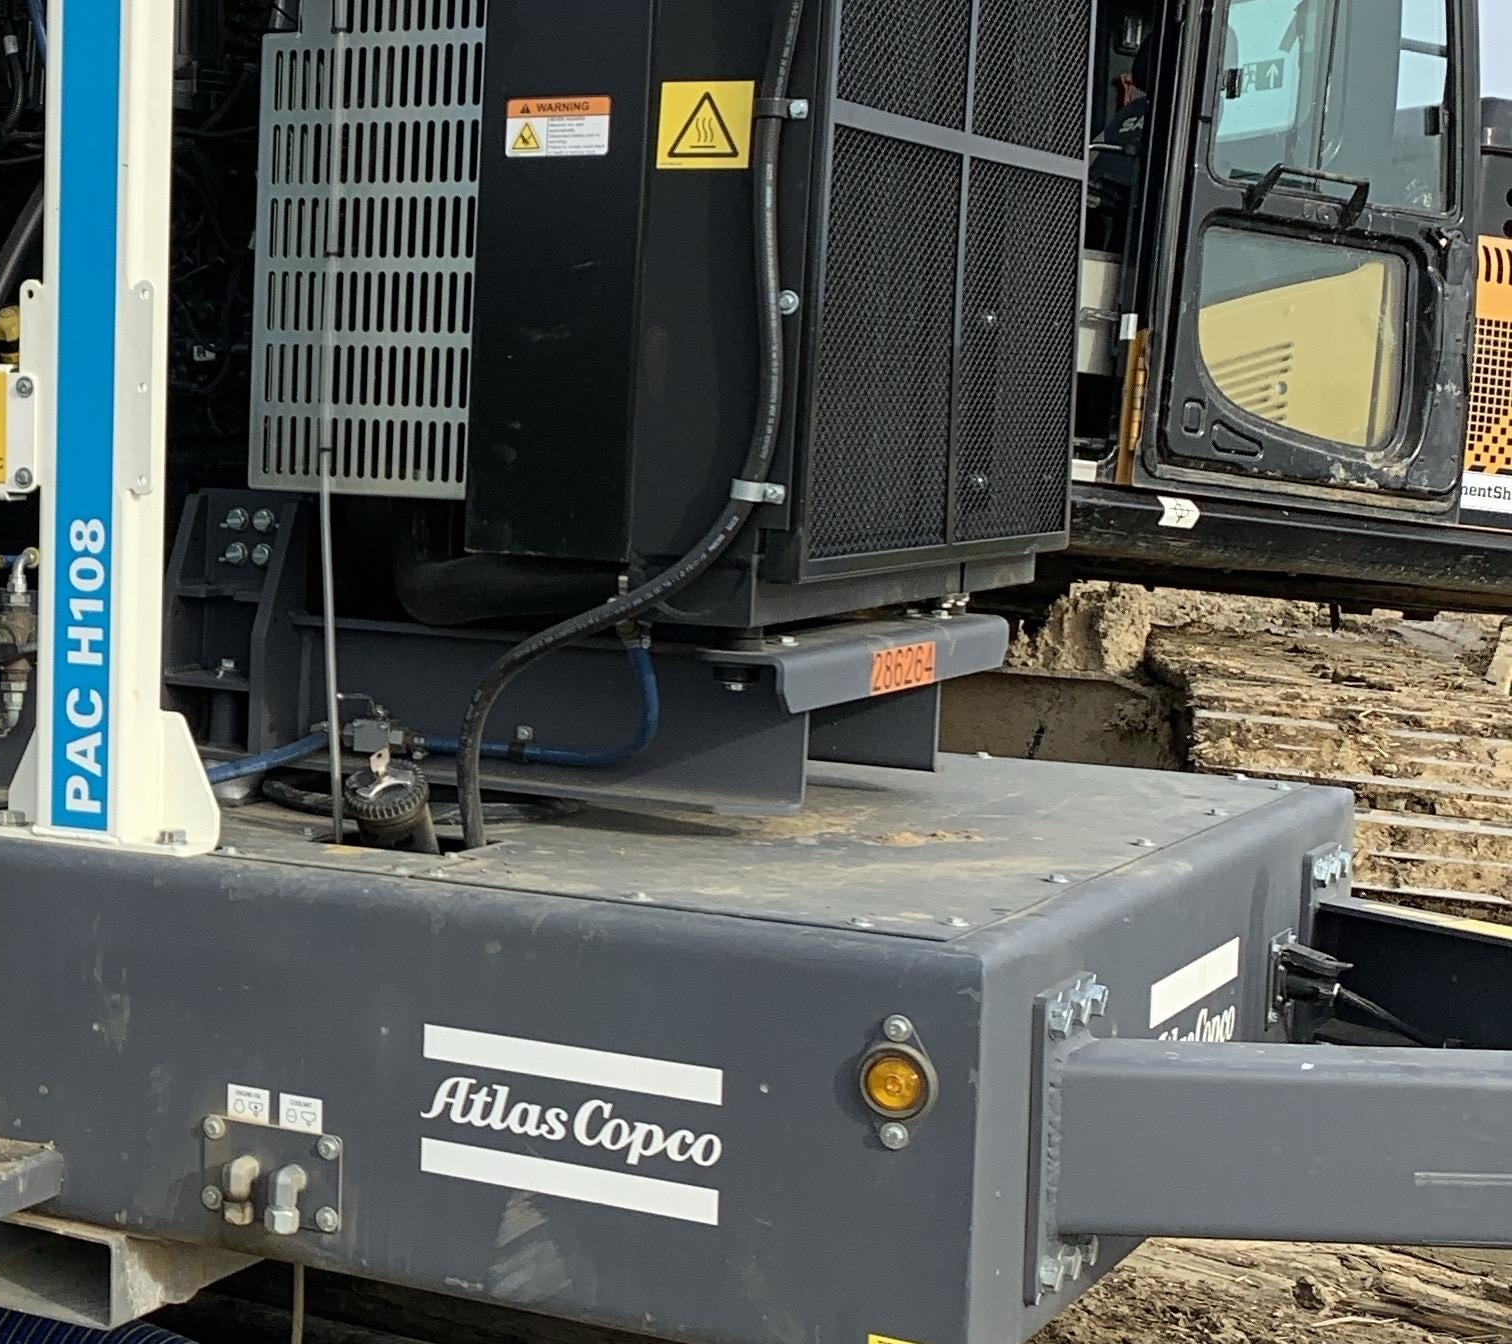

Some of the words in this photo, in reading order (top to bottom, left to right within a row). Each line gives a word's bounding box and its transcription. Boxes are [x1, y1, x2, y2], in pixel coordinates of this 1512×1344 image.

[536, 101, 590, 113] WARNING
[66, 518, 106, 667] H108
[872, 643, 934, 692] 286264
[64, 687, 103, 814] PAC
[419, 1076, 569, 1141] Atlas
[572, 1098, 724, 1168] Copco
